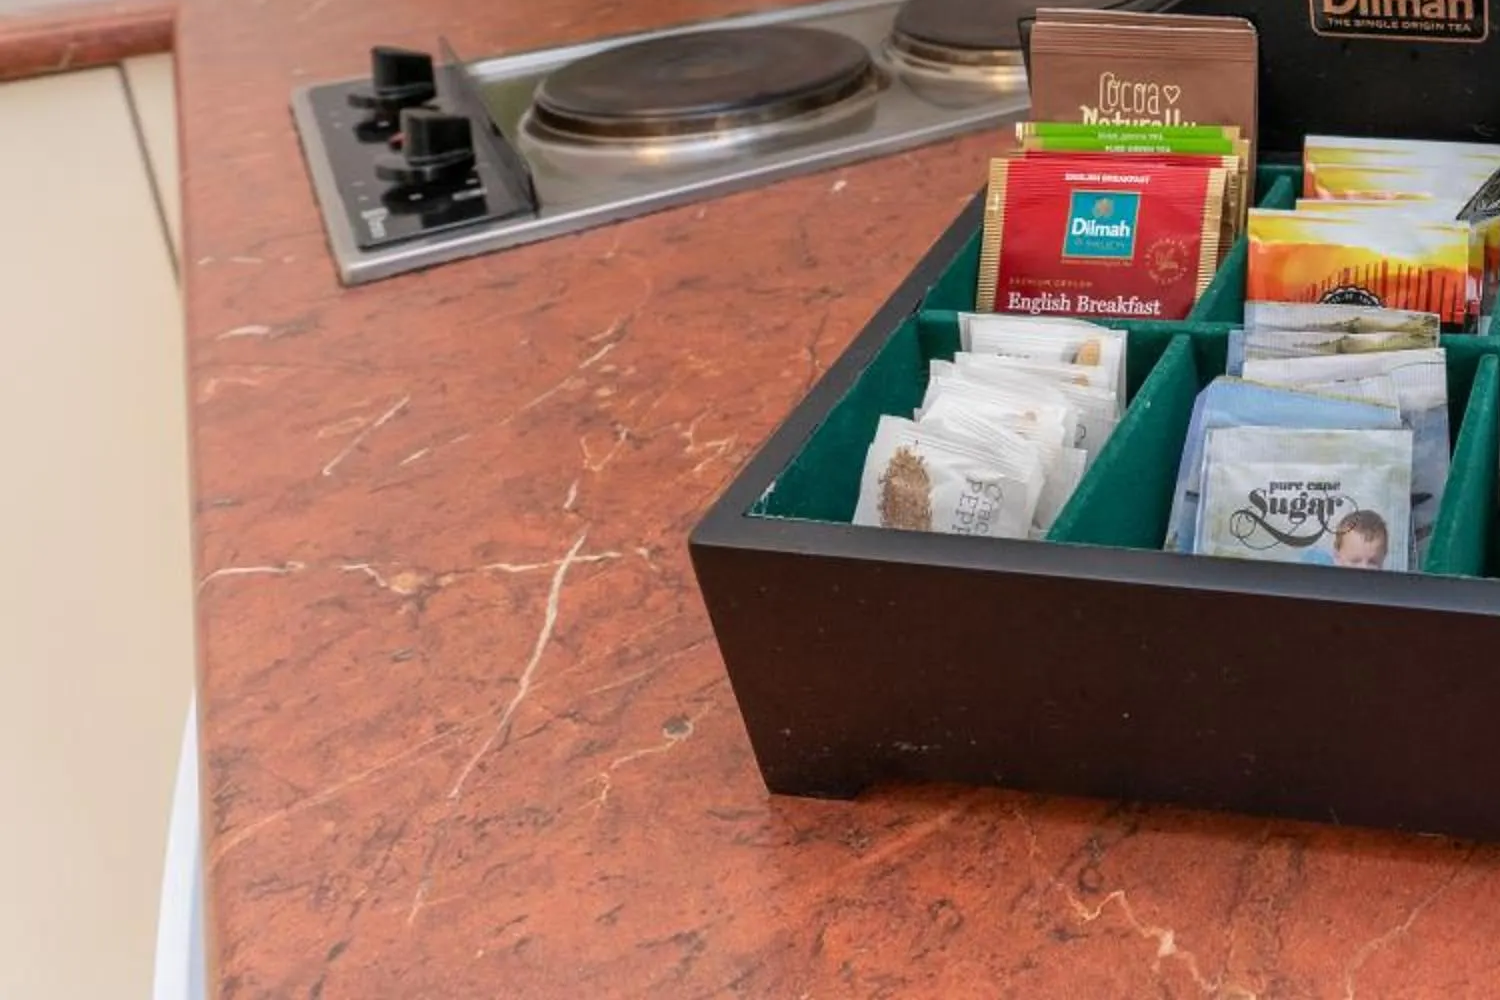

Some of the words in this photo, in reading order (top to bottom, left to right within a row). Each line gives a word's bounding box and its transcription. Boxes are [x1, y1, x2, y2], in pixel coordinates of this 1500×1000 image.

[1099, 71, 1161, 115] Cocoa
[1079, 104, 1197, 127] Ntrll
[1071, 217, 1131, 238] Dilmah
[1008, 291, 1071, 314] English
[1076, 294, 1161, 316] Breakfast
[1269, 481, 1303, 494] pure
[1306, 481, 1341, 491] cane
